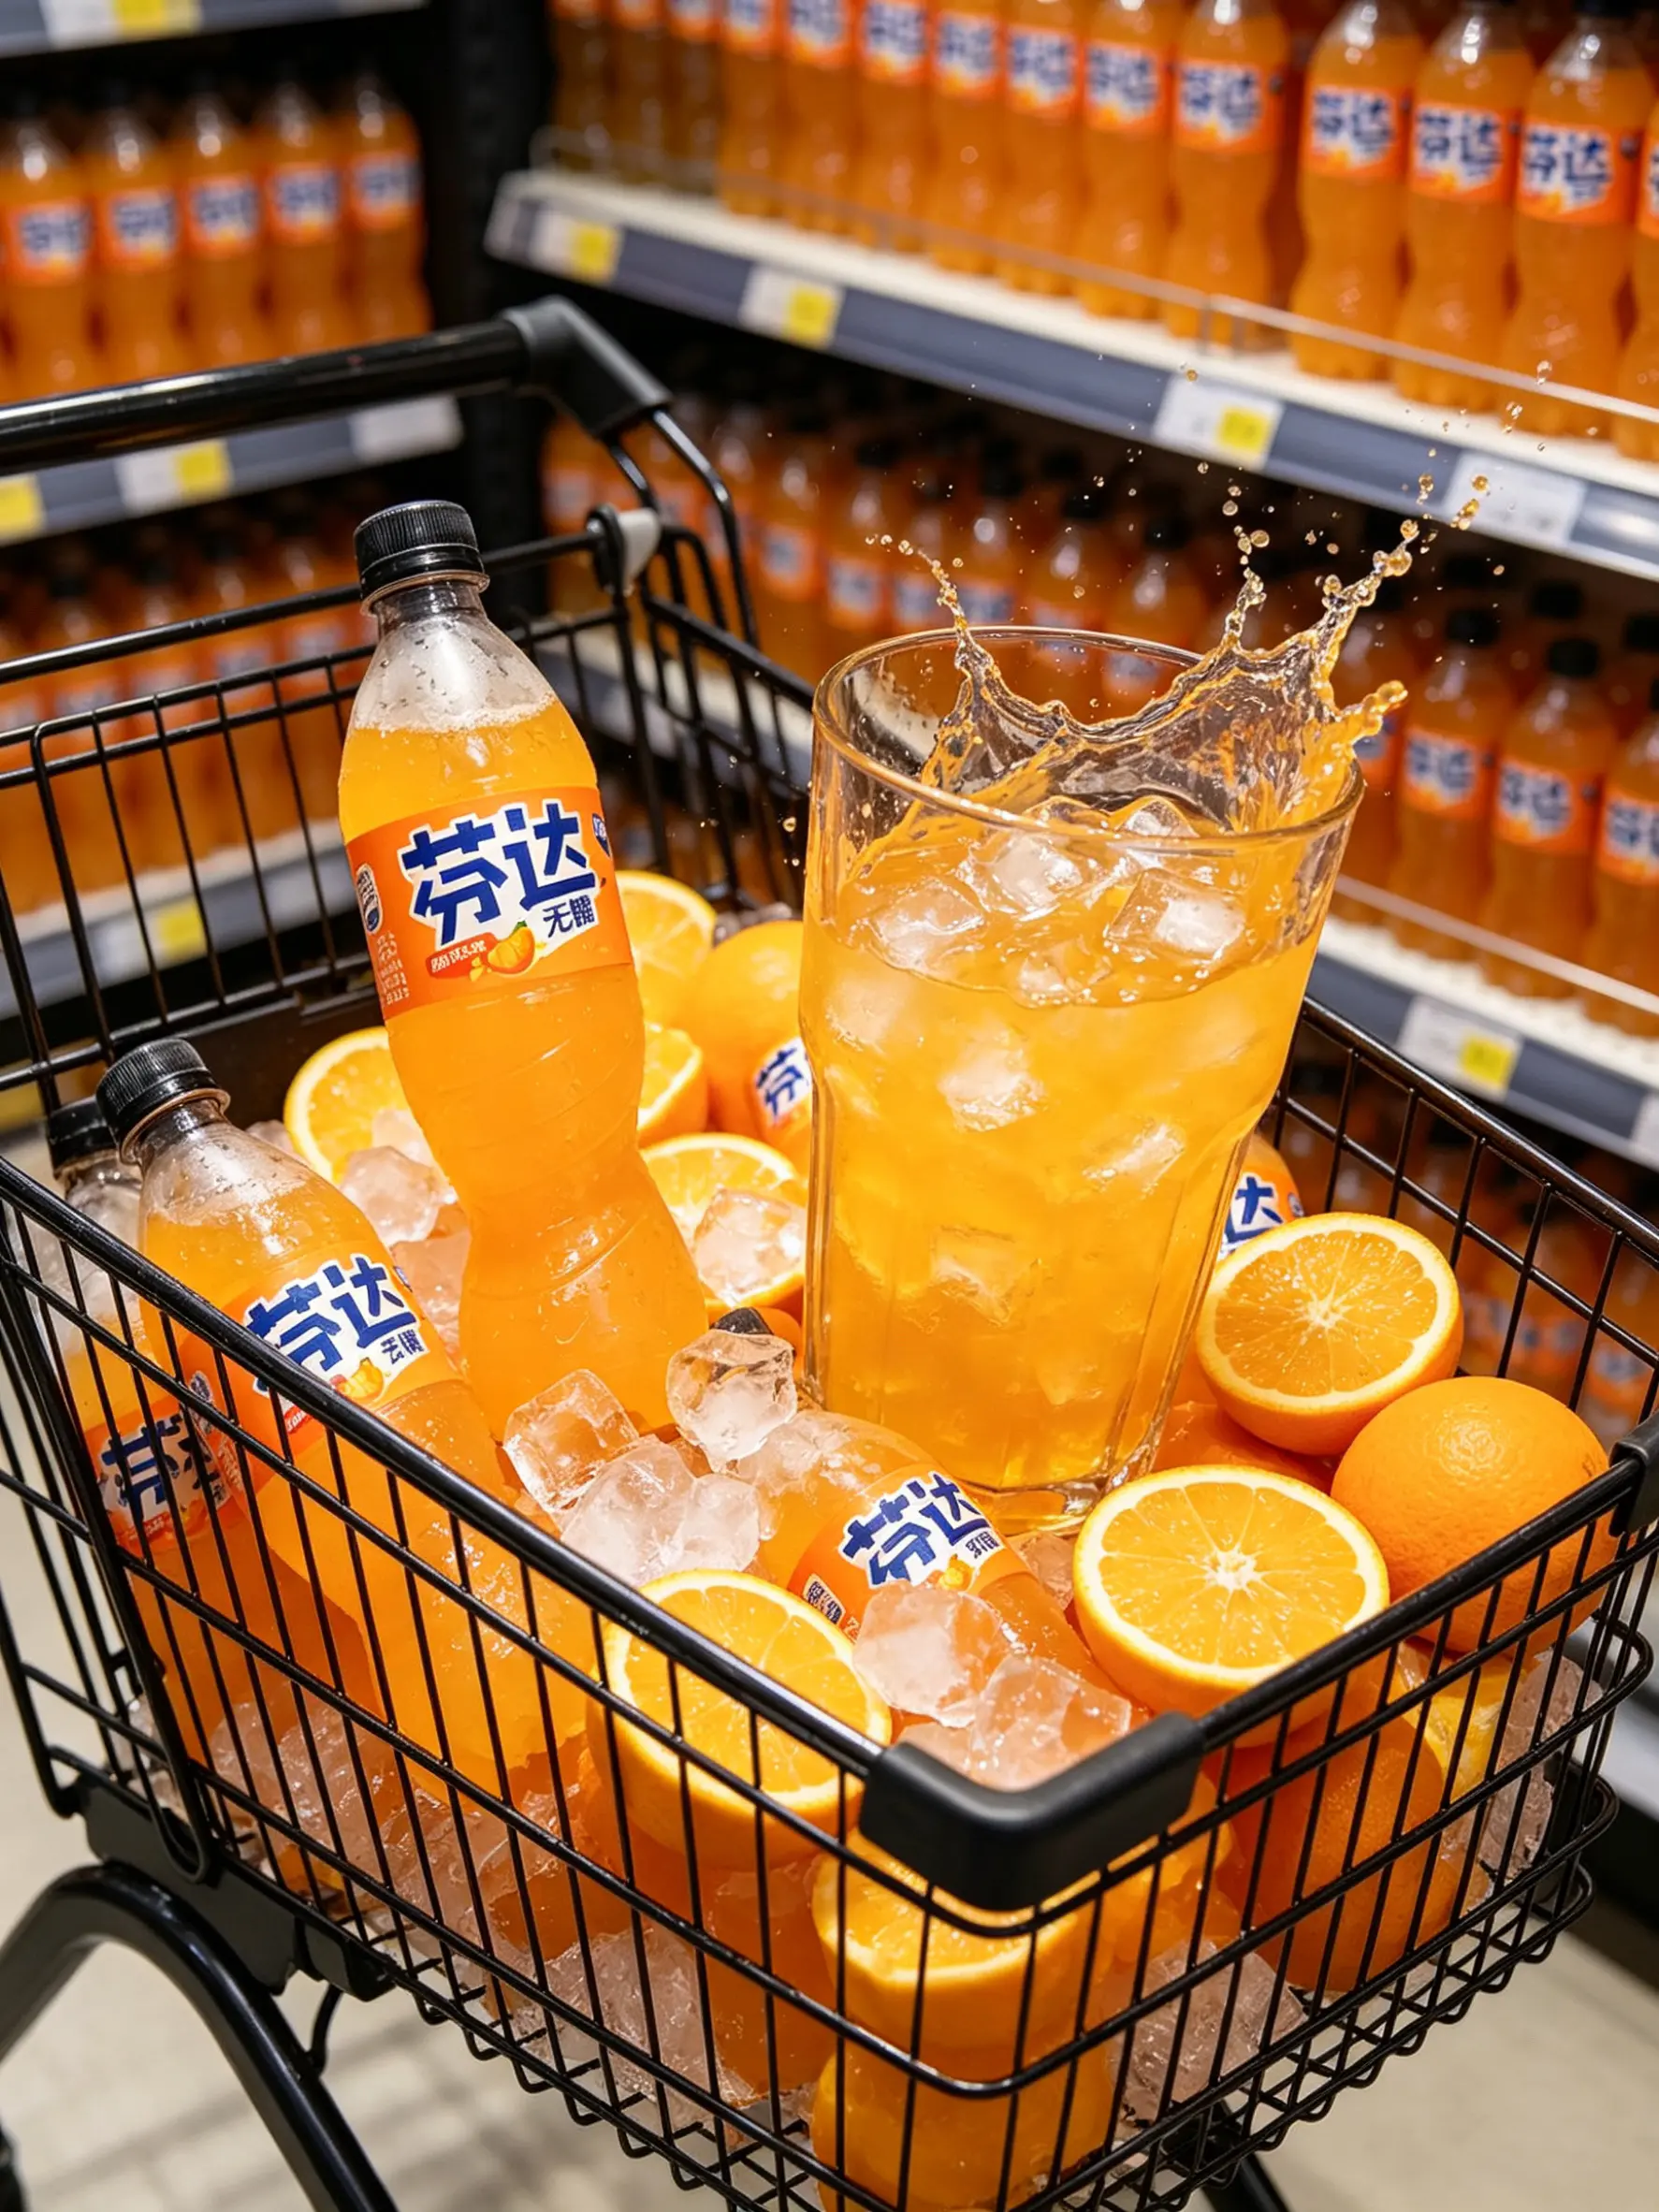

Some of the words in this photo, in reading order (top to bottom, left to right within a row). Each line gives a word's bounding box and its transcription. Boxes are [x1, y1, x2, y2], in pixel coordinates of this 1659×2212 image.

[400, 802, 596, 946] 芬达
[245, 1257, 416, 1391] 芬达
[842, 1473, 991, 1585] 芬达
